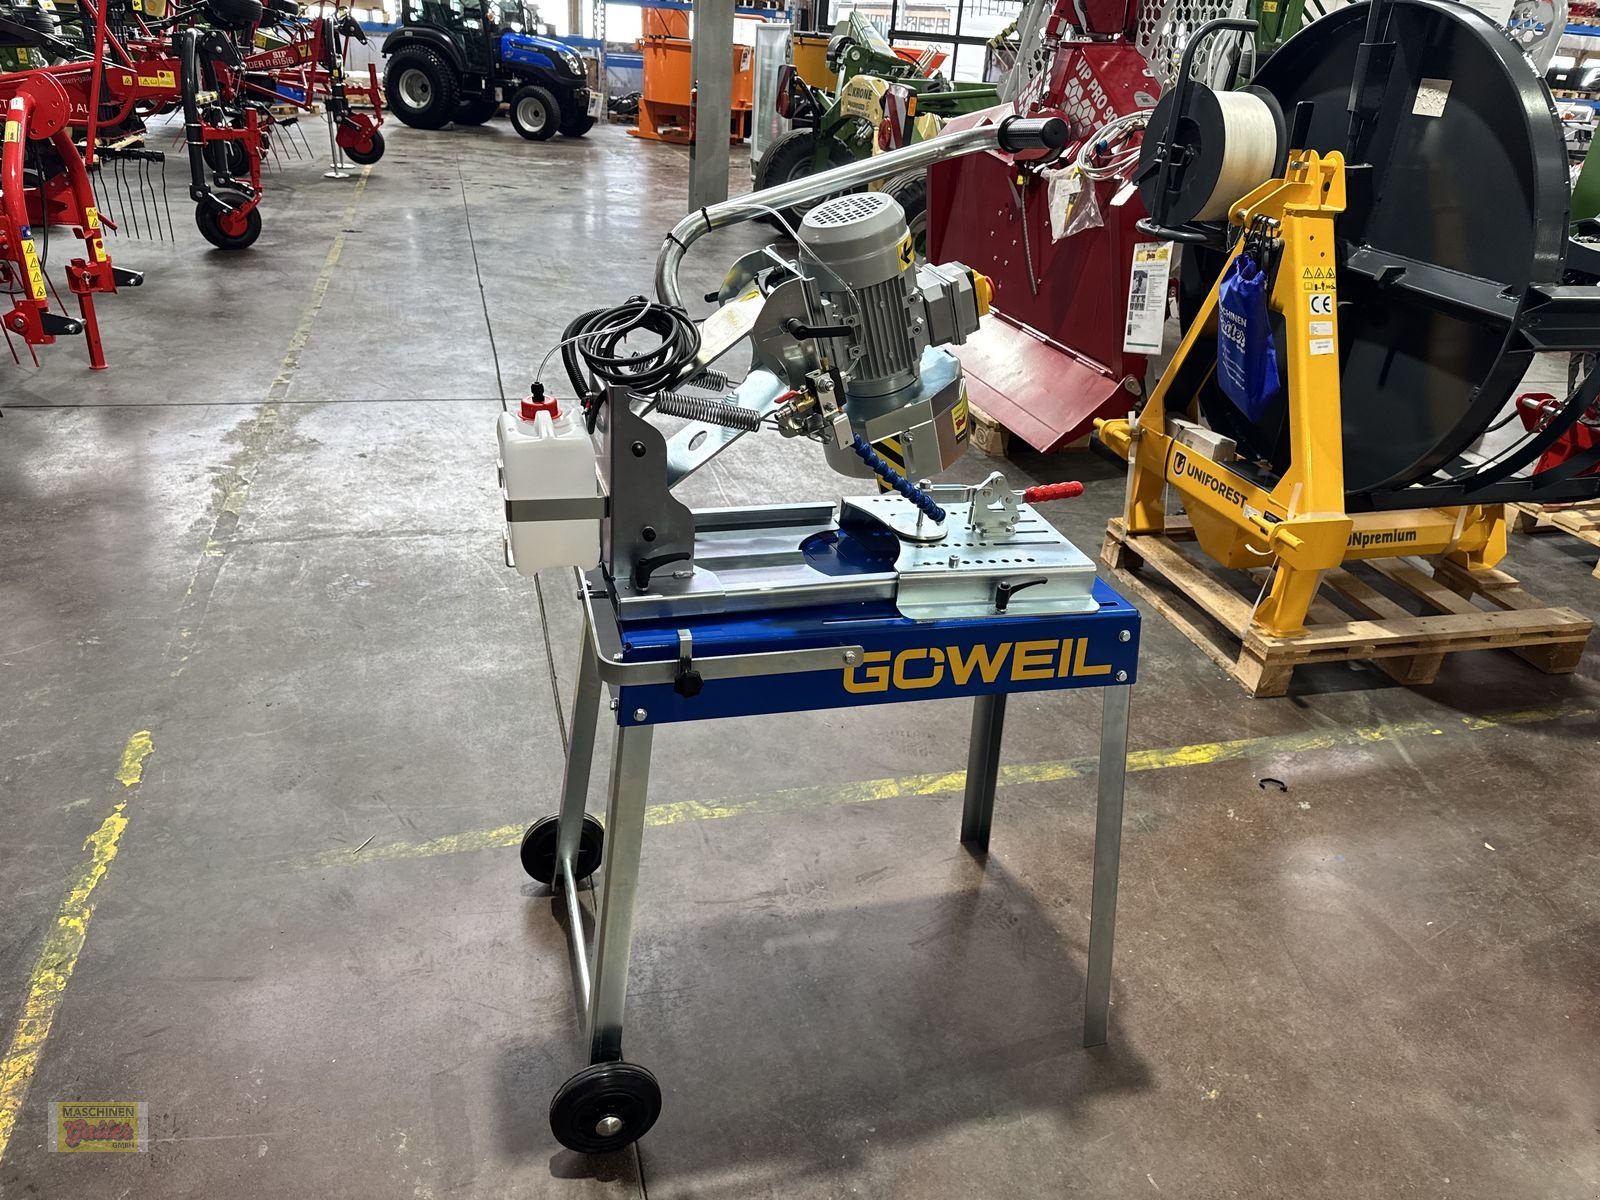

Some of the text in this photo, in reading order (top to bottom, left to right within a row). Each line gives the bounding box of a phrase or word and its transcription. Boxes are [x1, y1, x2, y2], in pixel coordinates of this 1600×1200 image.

[272, 50, 287, 59] SIP
[246, 60, 265, 69] DER
[1075, 55, 1093, 81] VIP
[1086, 77, 1108, 110] PRO
[852, 87, 873, 100] KRONE
[1186, 462, 1249, 509] UNIFOREST
